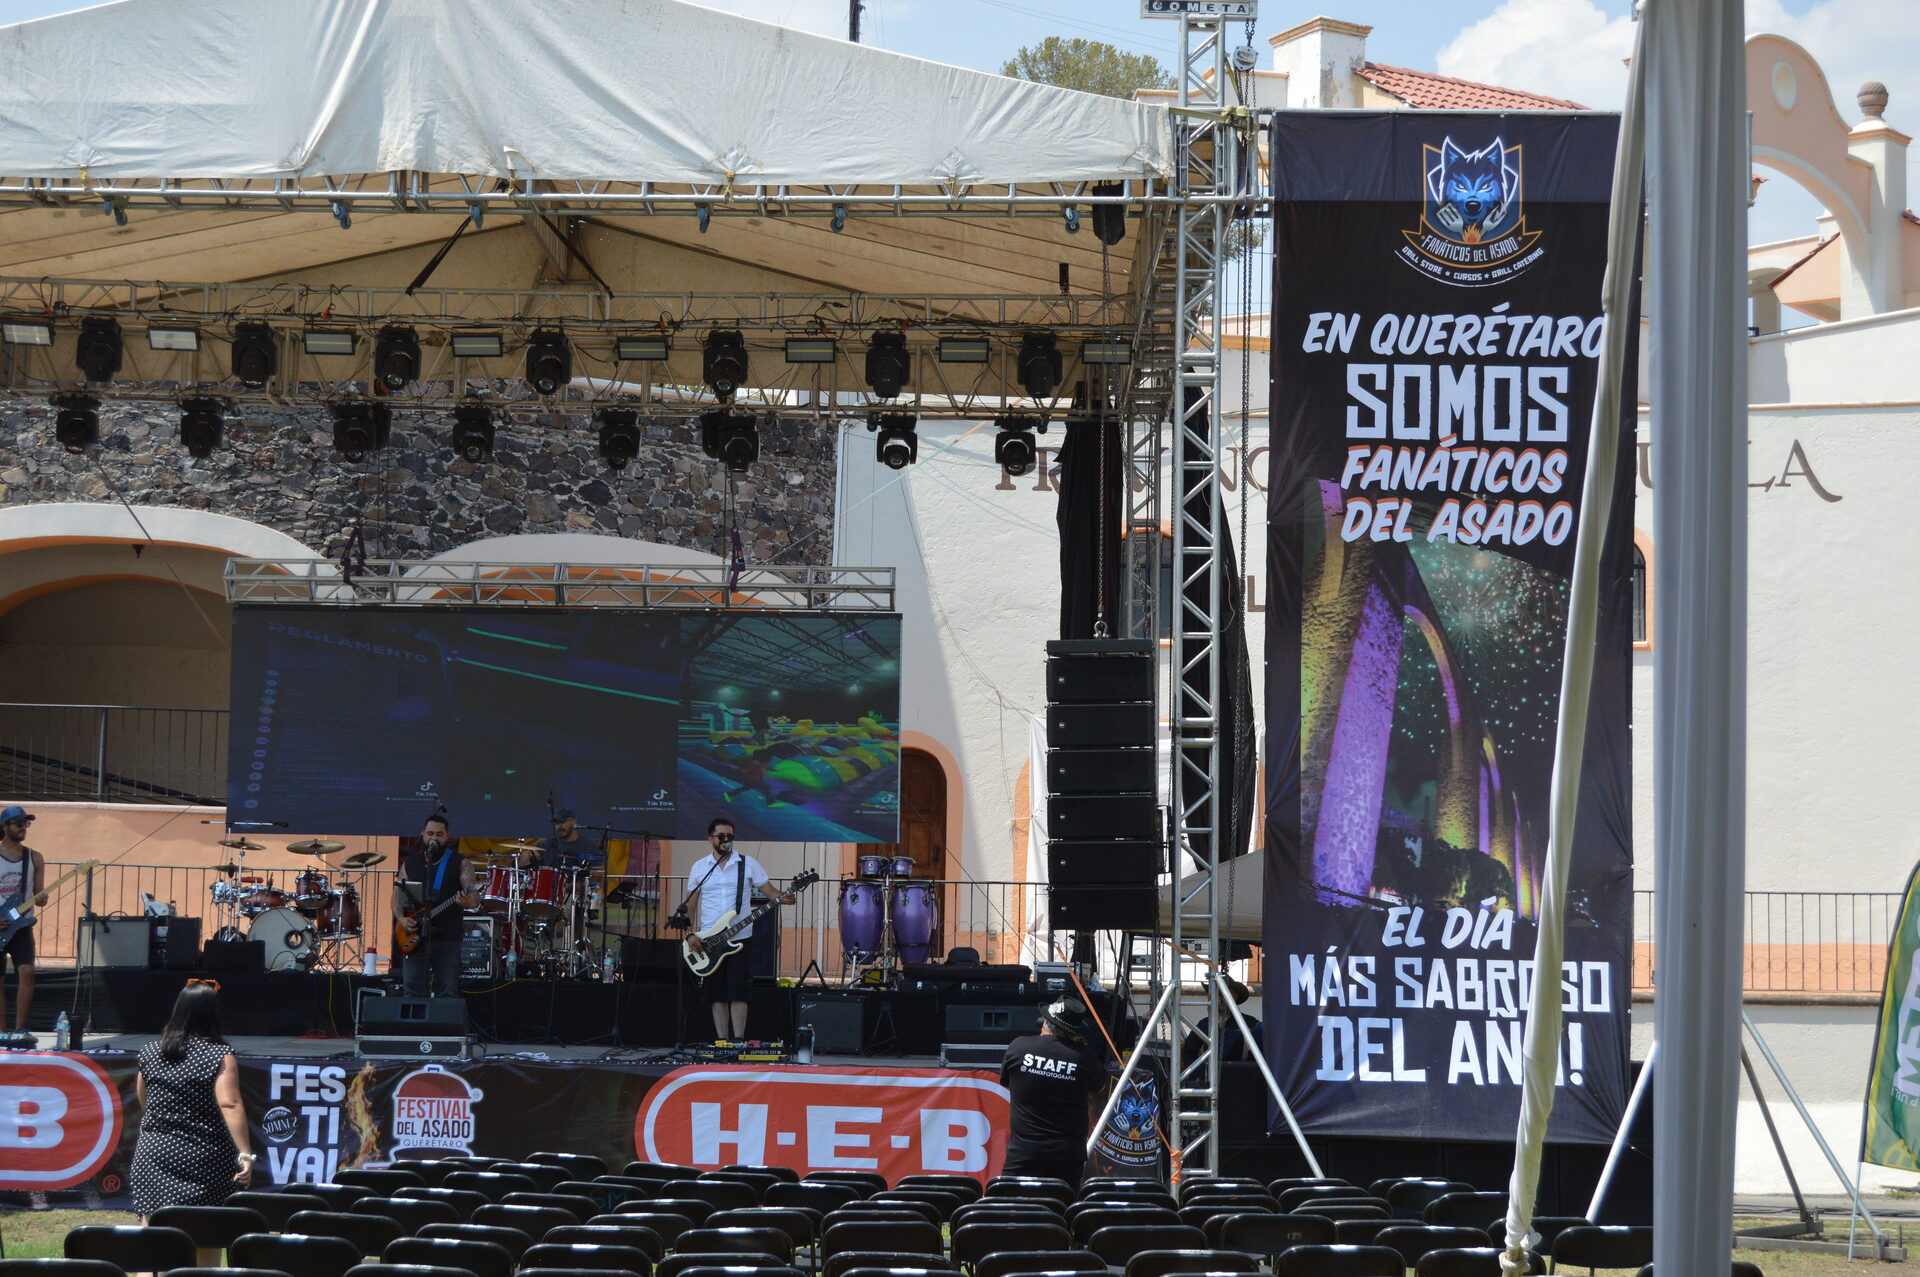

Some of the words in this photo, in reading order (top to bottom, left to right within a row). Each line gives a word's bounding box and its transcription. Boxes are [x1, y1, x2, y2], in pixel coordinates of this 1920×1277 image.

[1151, 1, 1247, 14] COMETA
[1401, 246, 1419, 263] GRILL
[1420, 259, 1443, 275] STORE
[1453, 272, 1483, 281] CURSOS
[1491, 268, 1513, 278] GRILL
[1513, 247, 1545, 271] CATERING
[1421, 234, 1470, 262] FANÁTICOS
[1473, 250, 1488, 262] DEL
[1490, 236, 1519, 259] ASADO
[1302, 312, 1361, 355] EN
[1370, 301, 1604, 358] QUERÉTARO
[1345, 363, 1569, 443] SOMOS
[1339, 433, 1568, 494] FANÁTICOS
[1340, 497, 1413, 544] DEL
[1427, 498, 1573, 547] ASADO
[1382, 906, 1425, 948] EL
[1441, 895, 1514, 950] DÍA
[1289, 945, 1377, 1008] MÁS
[1023, 1053, 1077, 1074] STAFF
[1316, 1015, 1426, 1083] DEL
[1447, 1007, 1583, 1087] AÑ!
[271, 1063, 346, 1102] FES
[301, 1105, 340, 1144] TI
[397, 1098, 471, 1120] FESTIVAL
[397, 1121, 417, 1135] DEL
[421, 1119, 470, 1139] ASADO
[403, 1138, 463, 1148] QUERÉTARO
[691, 1102, 991, 1173] H-E-B
